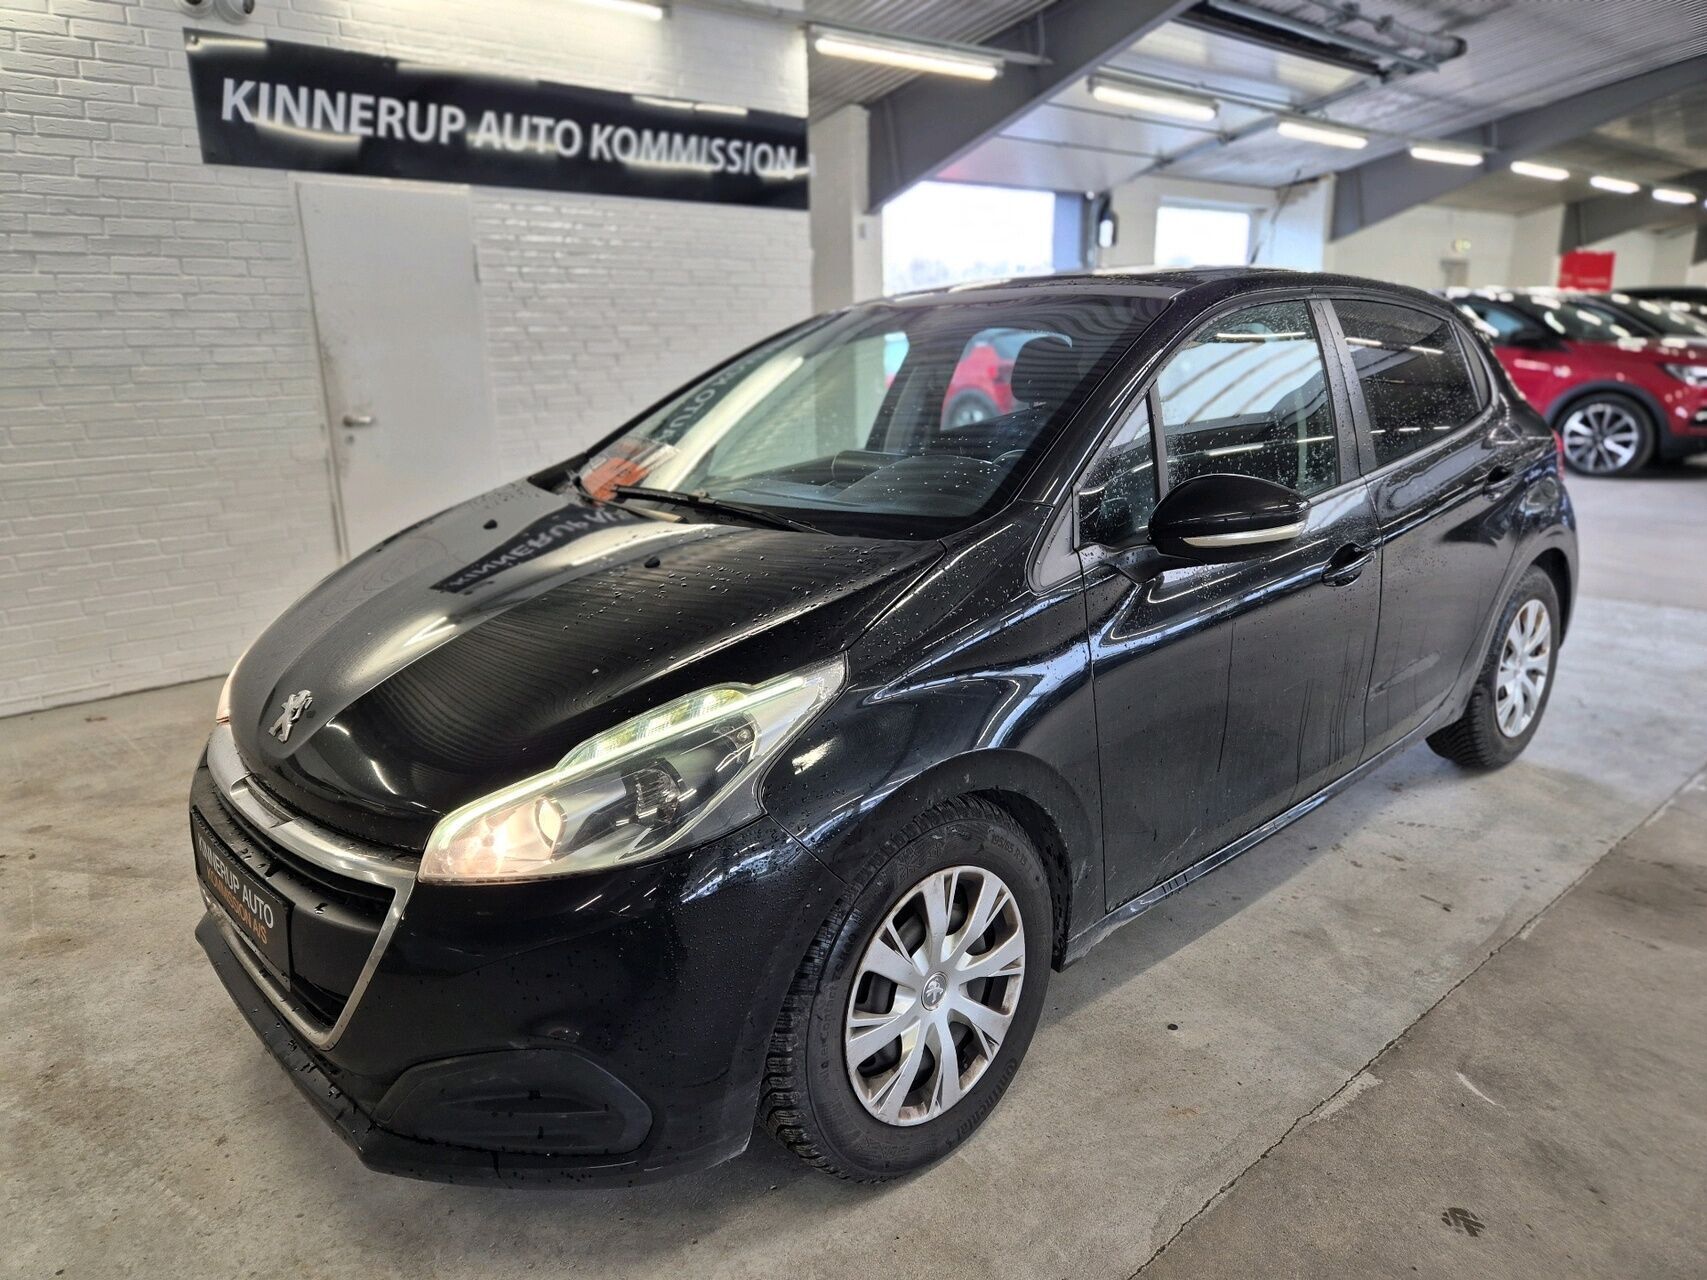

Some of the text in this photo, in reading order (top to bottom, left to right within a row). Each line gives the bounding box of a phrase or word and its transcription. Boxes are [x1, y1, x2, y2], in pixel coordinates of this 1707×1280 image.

[221, 77, 467, 145] KINNERUP
[473, 110, 582, 156] AUTO
[589, 123, 797, 180] KOMMISSION
[197, 833, 274, 929] KINNERUP AUTO
